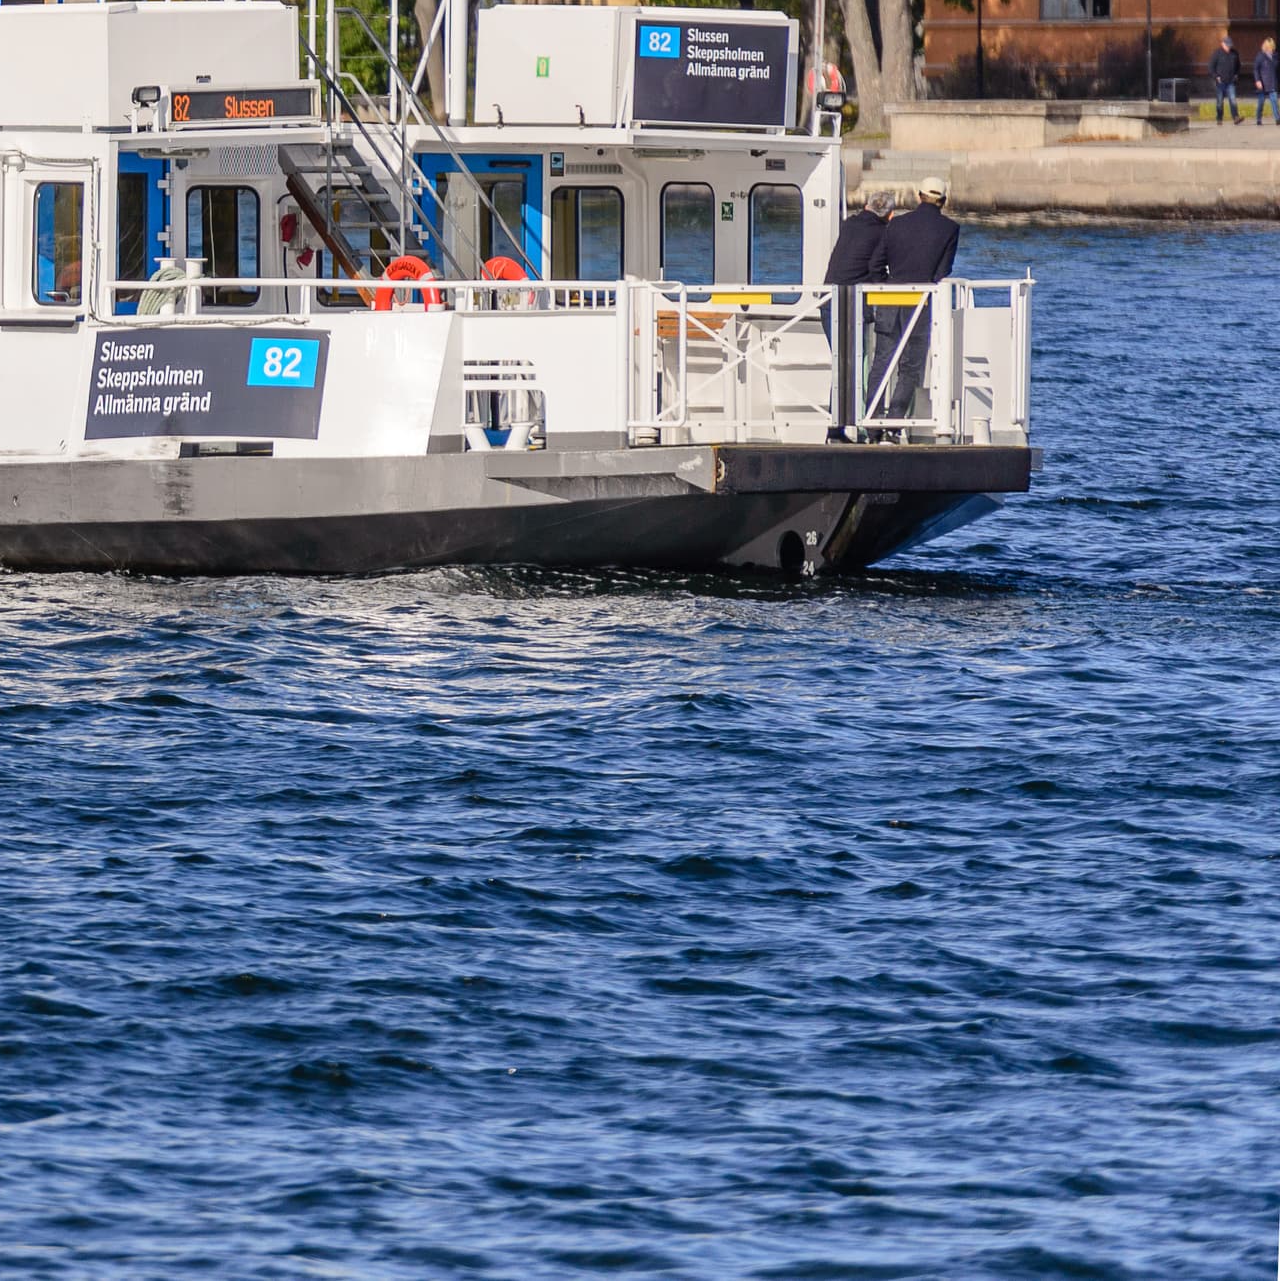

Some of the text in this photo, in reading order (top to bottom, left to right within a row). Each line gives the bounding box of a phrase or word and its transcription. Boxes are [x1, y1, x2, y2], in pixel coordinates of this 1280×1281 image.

[648, 31, 672, 53] 82
[686, 27, 730, 44] Slussen
[686, 44, 765, 63] Skeppsholmen
[686, 61, 771, 81] Allmänna gränd
[173, 94, 275, 121] 82 Slussen
[100, 340, 155, 363] Slussen
[262, 346, 303, 379] 82
[96, 365, 205, 392] Skeppsholmen
[93, 391, 212, 417] Allmänna gränd
[805, 529, 817, 546] 26
[802, 559, 815, 576] 24
